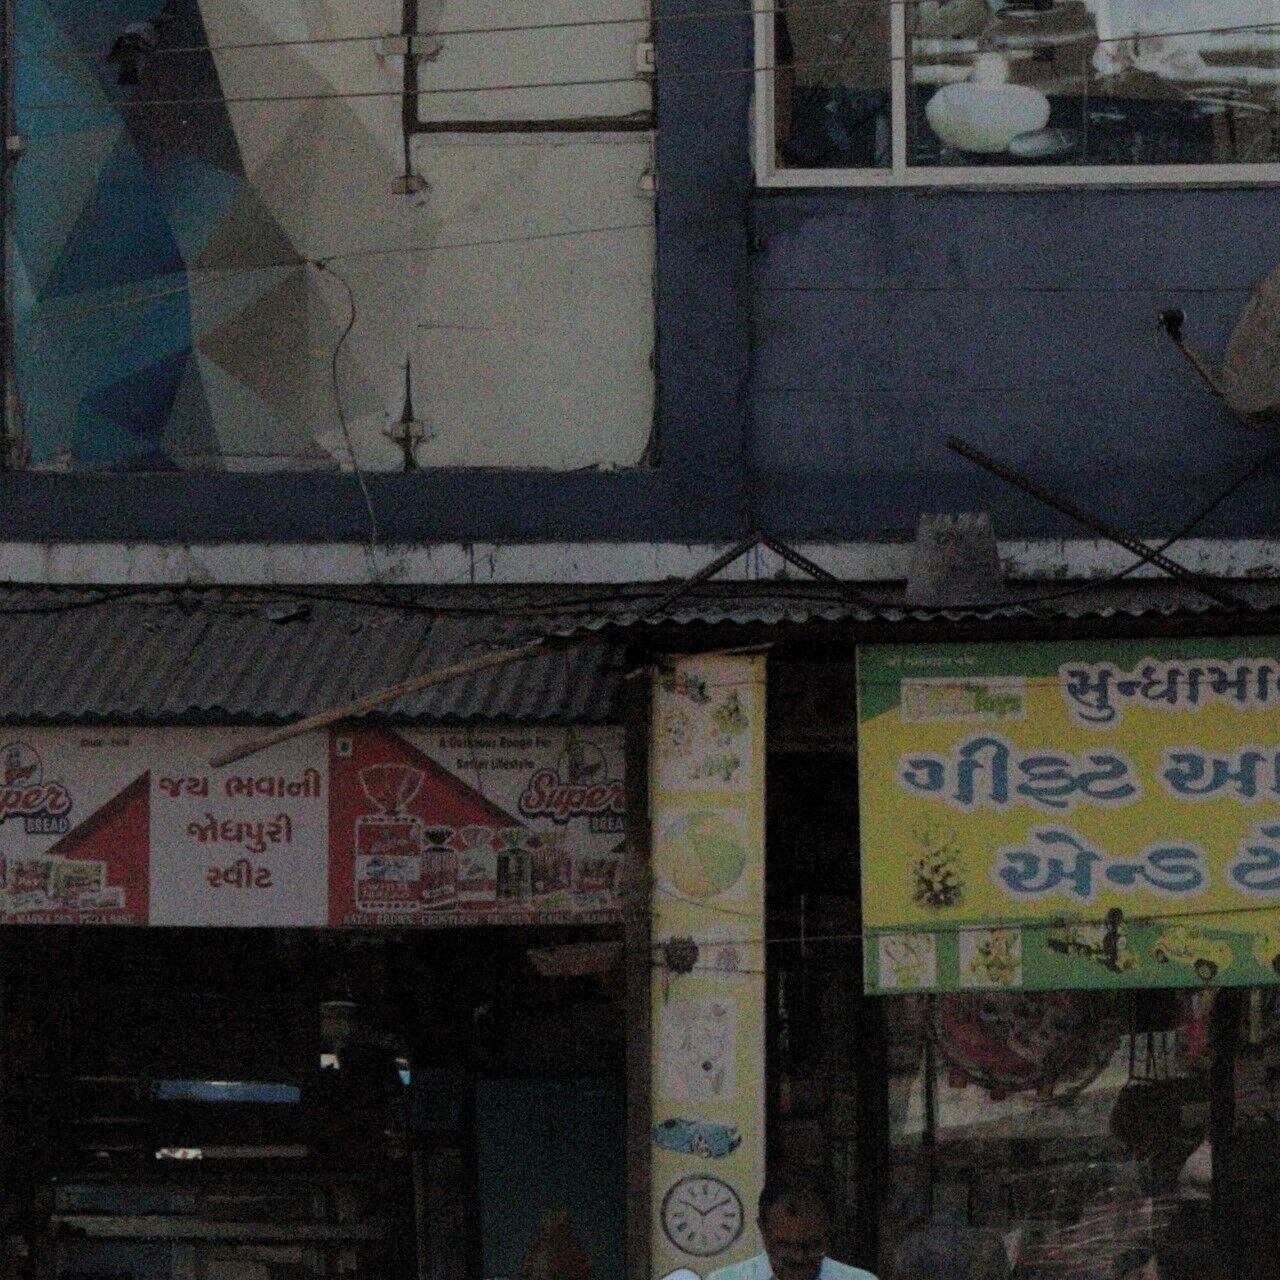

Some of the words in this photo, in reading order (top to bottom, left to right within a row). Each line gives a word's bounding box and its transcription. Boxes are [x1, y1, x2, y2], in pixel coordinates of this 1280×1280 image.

[158, 776, 209, 798] જય
[225, 767, 322, 799] ભવાની
[26, 815, 68, 834] BREAD
[187, 813, 293, 854] જોધપુરી
[998, 829, 1204, 896] એન્ડ
